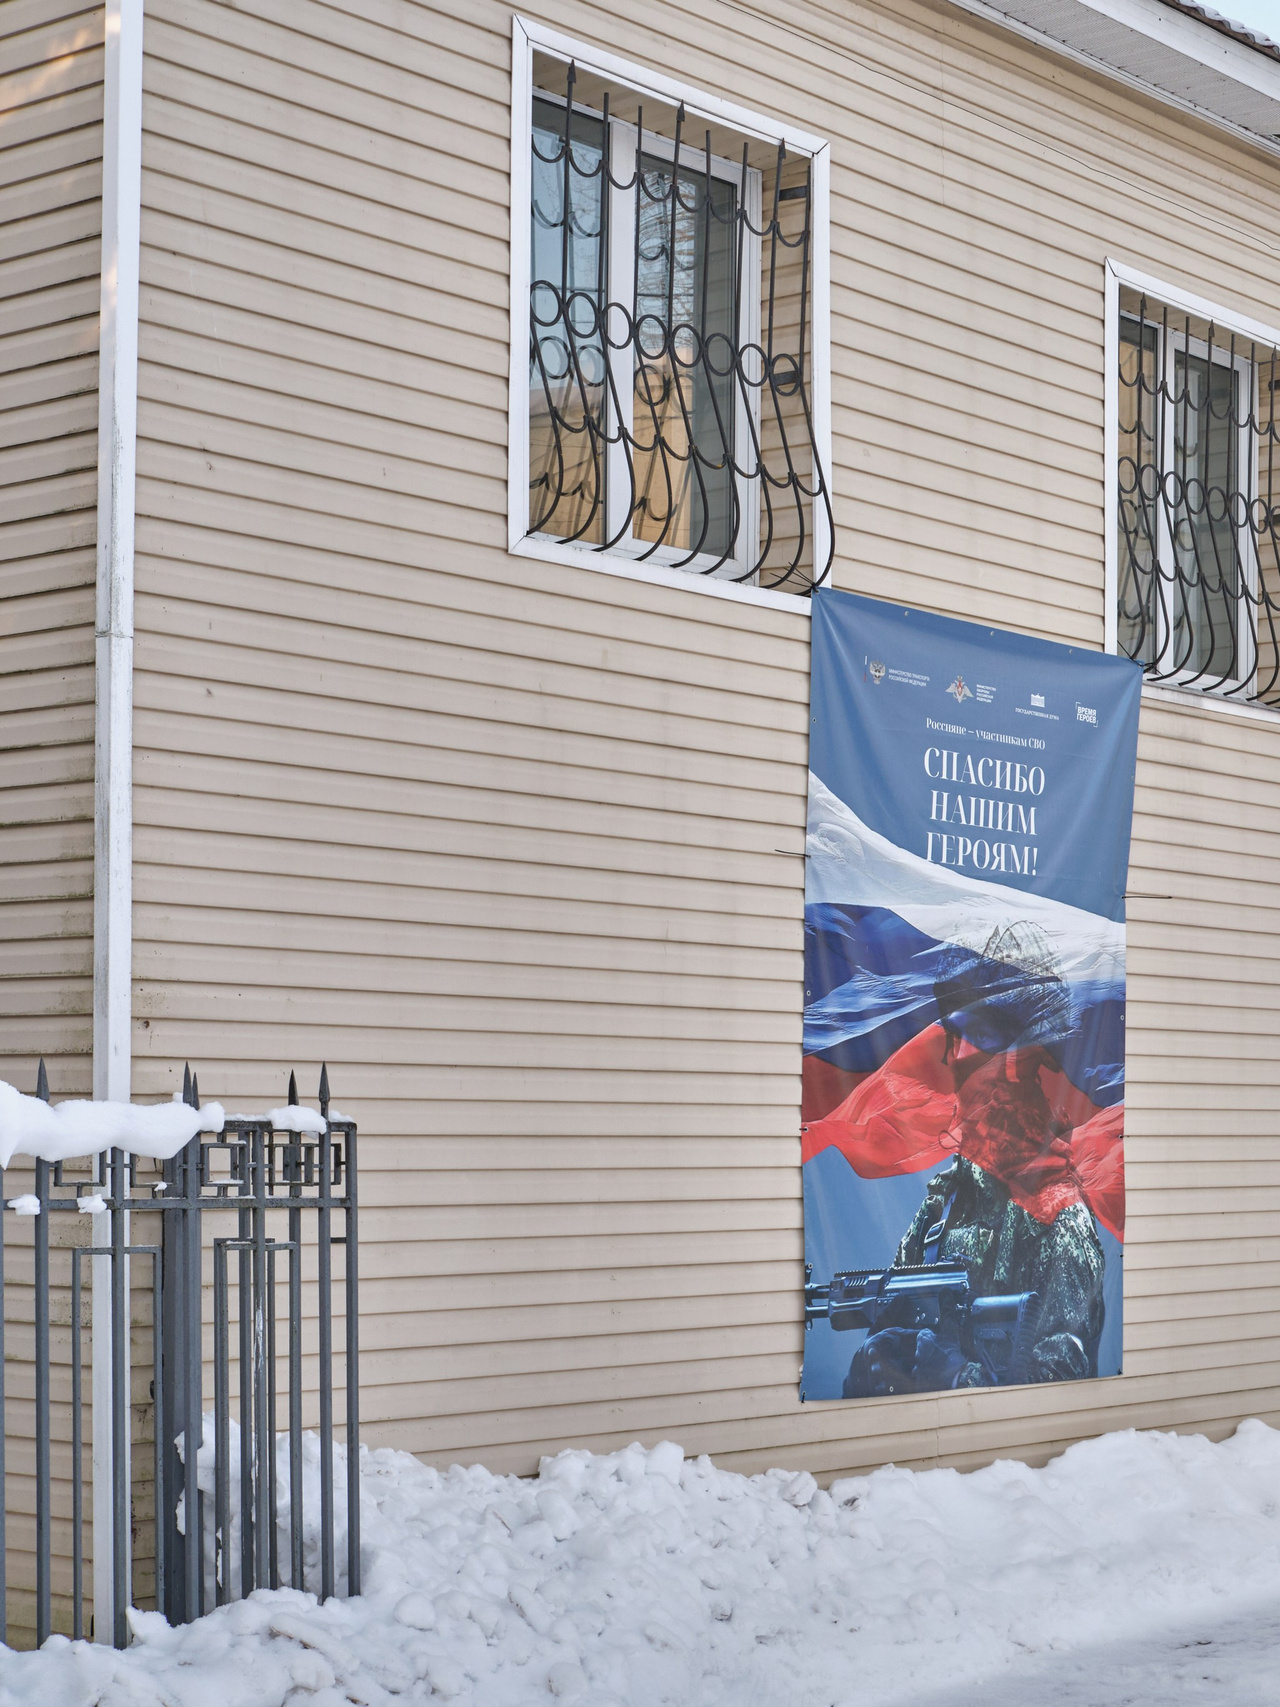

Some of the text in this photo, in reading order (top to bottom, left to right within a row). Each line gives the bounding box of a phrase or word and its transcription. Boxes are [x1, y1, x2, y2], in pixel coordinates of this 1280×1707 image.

[1076, 713, 1097, 724] ГЕРОЕВ
[1077, 706, 1097, 717] ВРЕМЯ
[926, 717, 967, 736] Россияне
[976, 729, 1027, 748] участникам
[1028, 737, 1046, 750] СВО
[924, 747, 1045, 796] СПАСИБО
[929, 790, 1038, 836] НАШИМ
[926, 831, 1038, 876] ГЕРОЯМ!
